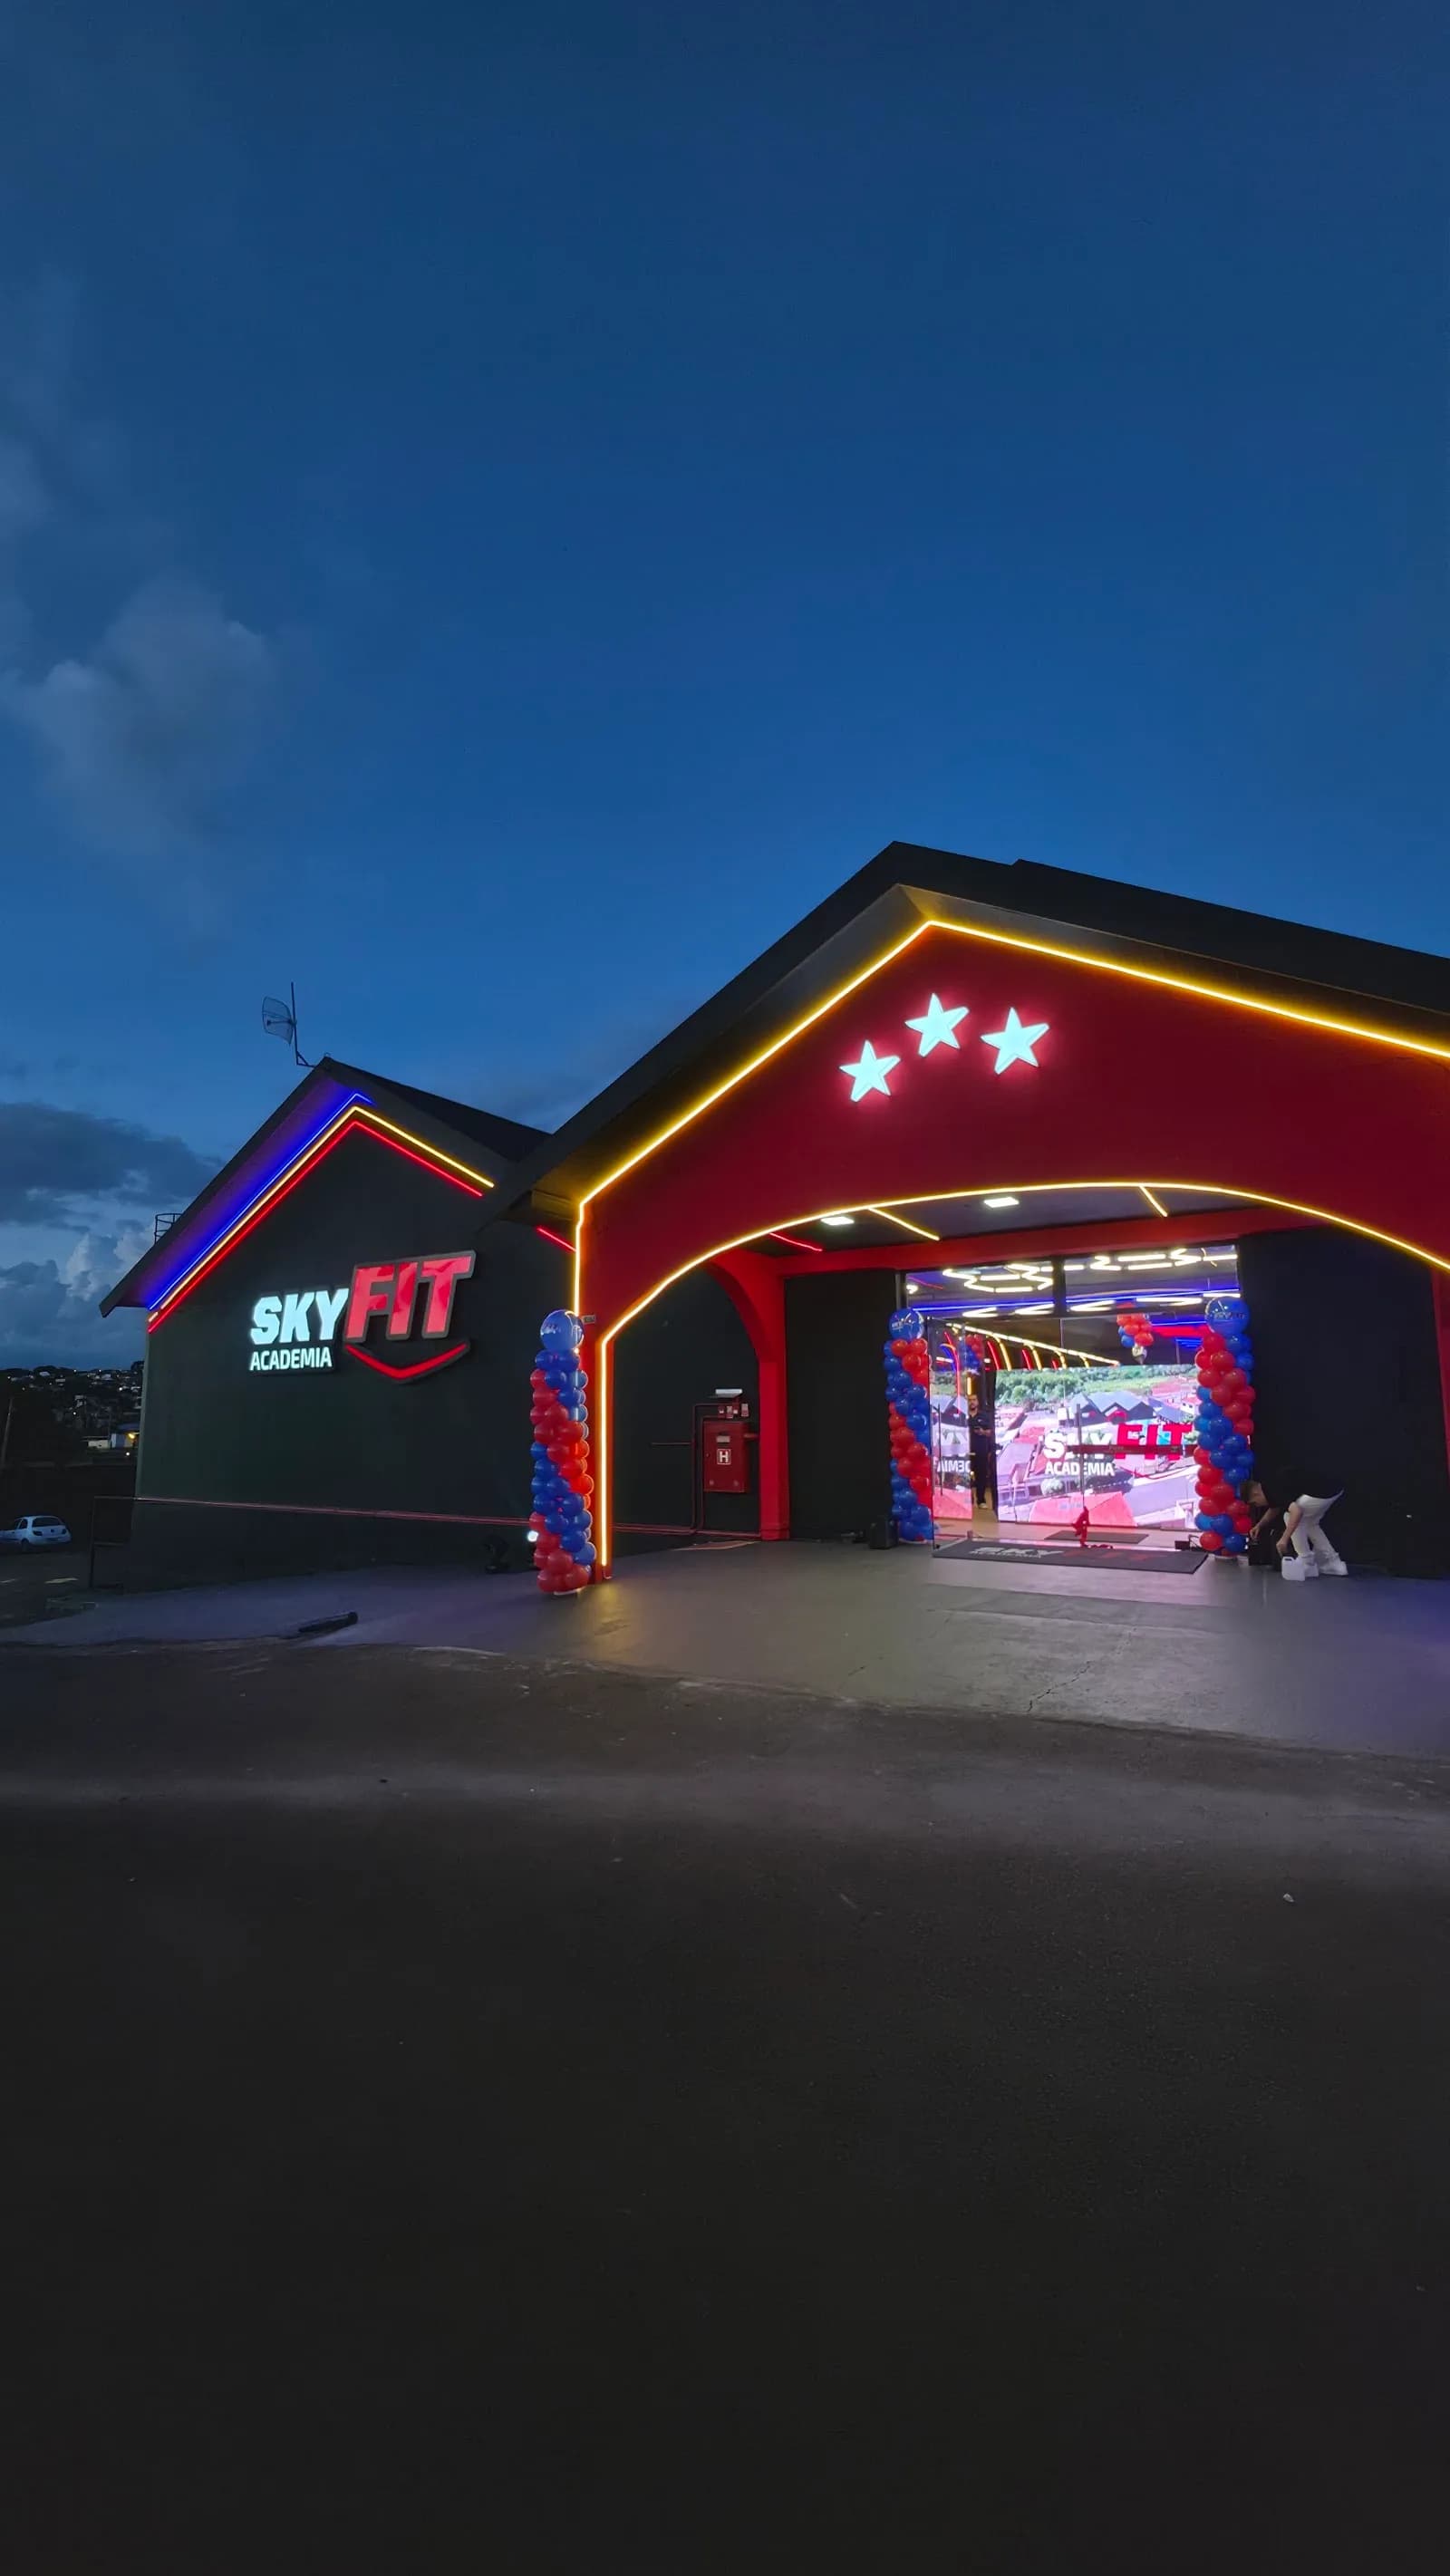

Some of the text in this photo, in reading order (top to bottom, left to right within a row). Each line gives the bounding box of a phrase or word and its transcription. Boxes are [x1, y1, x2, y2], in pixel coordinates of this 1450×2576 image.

[250, 1255, 471, 1345] SKY FIT
[249, 1346, 332, 1371] ACADEMIA
[720, 1451, 729, 1463] H
